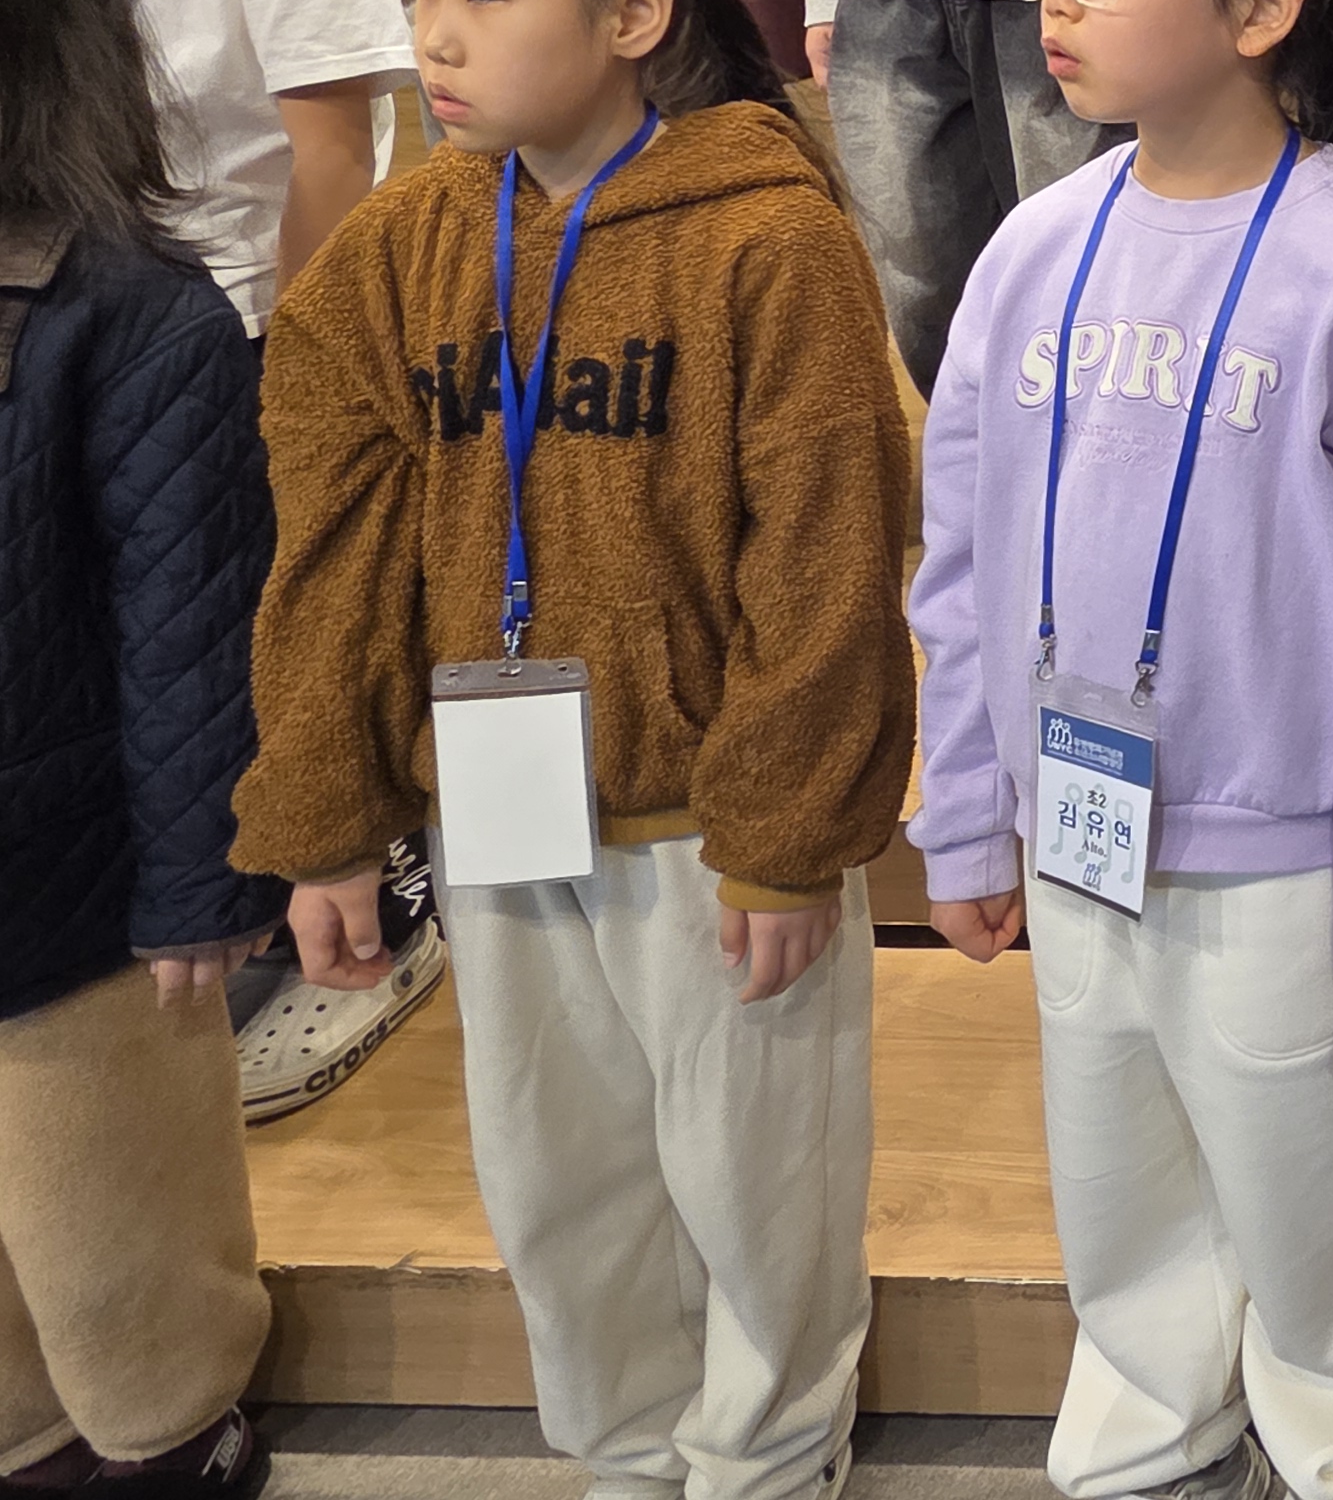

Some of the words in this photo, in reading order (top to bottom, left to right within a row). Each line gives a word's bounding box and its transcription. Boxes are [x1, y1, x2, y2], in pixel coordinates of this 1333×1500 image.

[1014, 317, 1282, 434] SPIRIT
[1086, 789, 1107, 809] 초2
[304, 1016, 388, 1094] crocs
